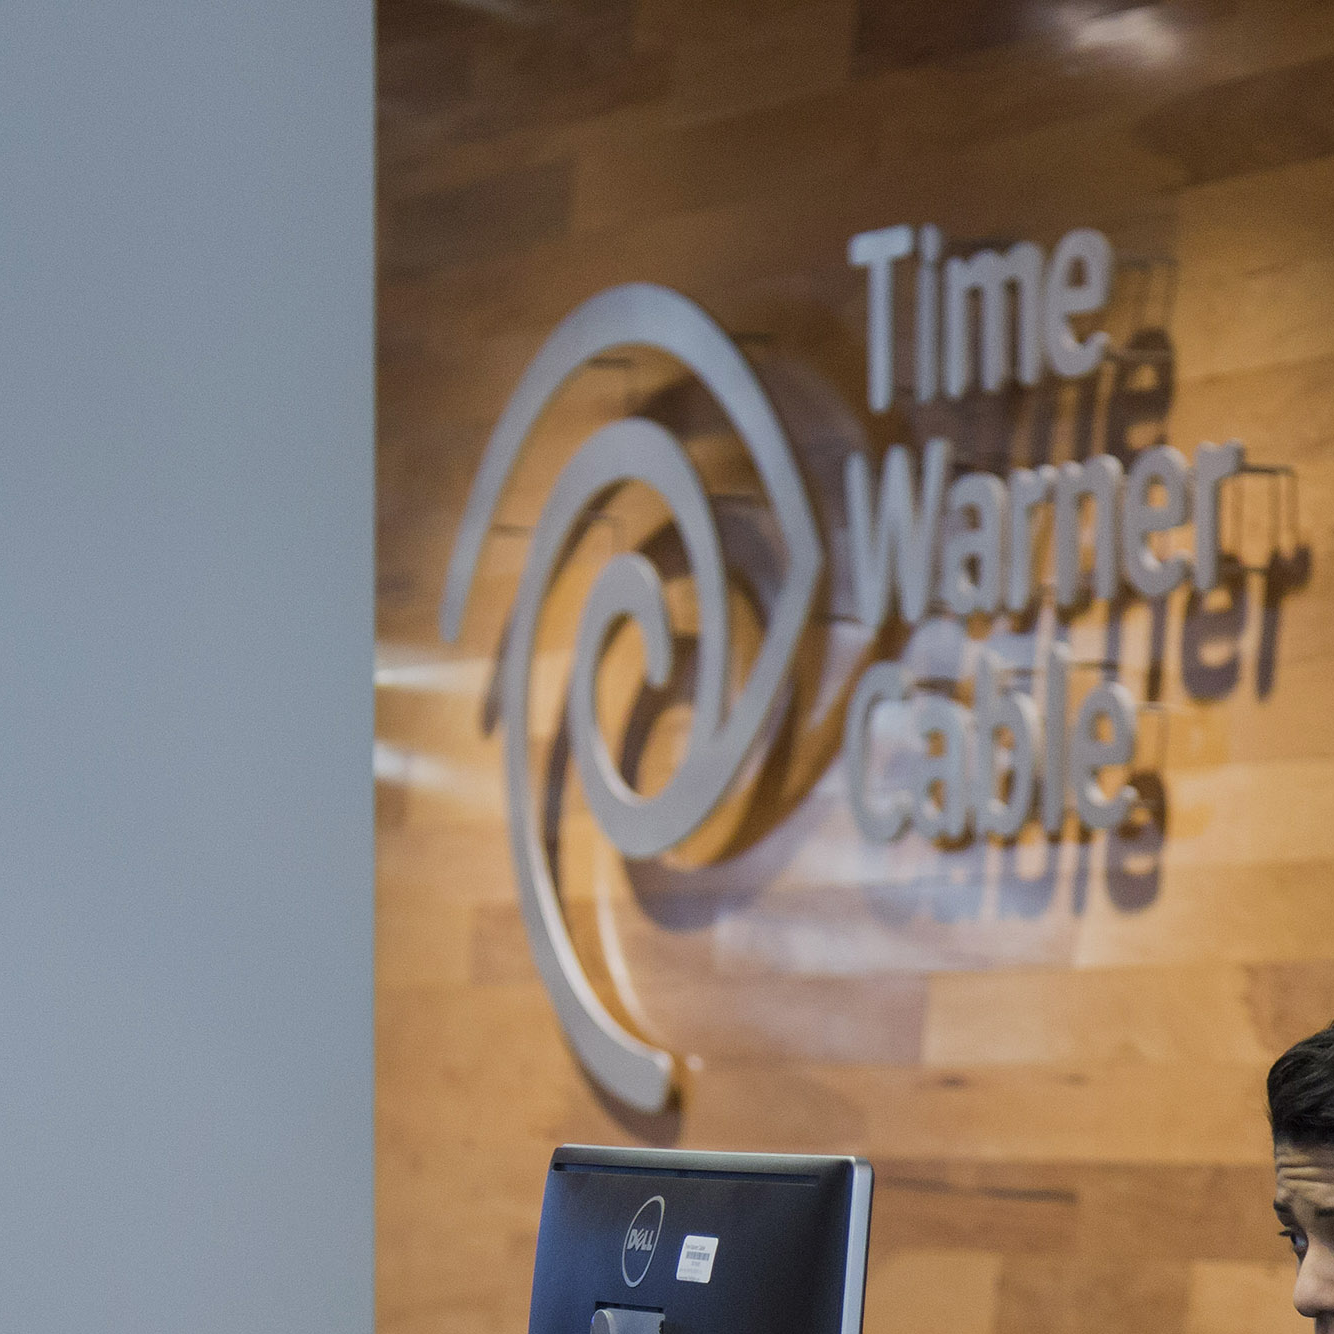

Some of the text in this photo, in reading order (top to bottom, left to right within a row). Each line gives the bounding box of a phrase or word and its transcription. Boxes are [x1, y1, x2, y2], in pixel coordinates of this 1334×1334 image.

[847, 222, 1113, 414] Time
[842, 436, 1246, 632] Warner
[843, 637, 1138, 845] Cable
[626, 1227, 655, 1252] DELL
